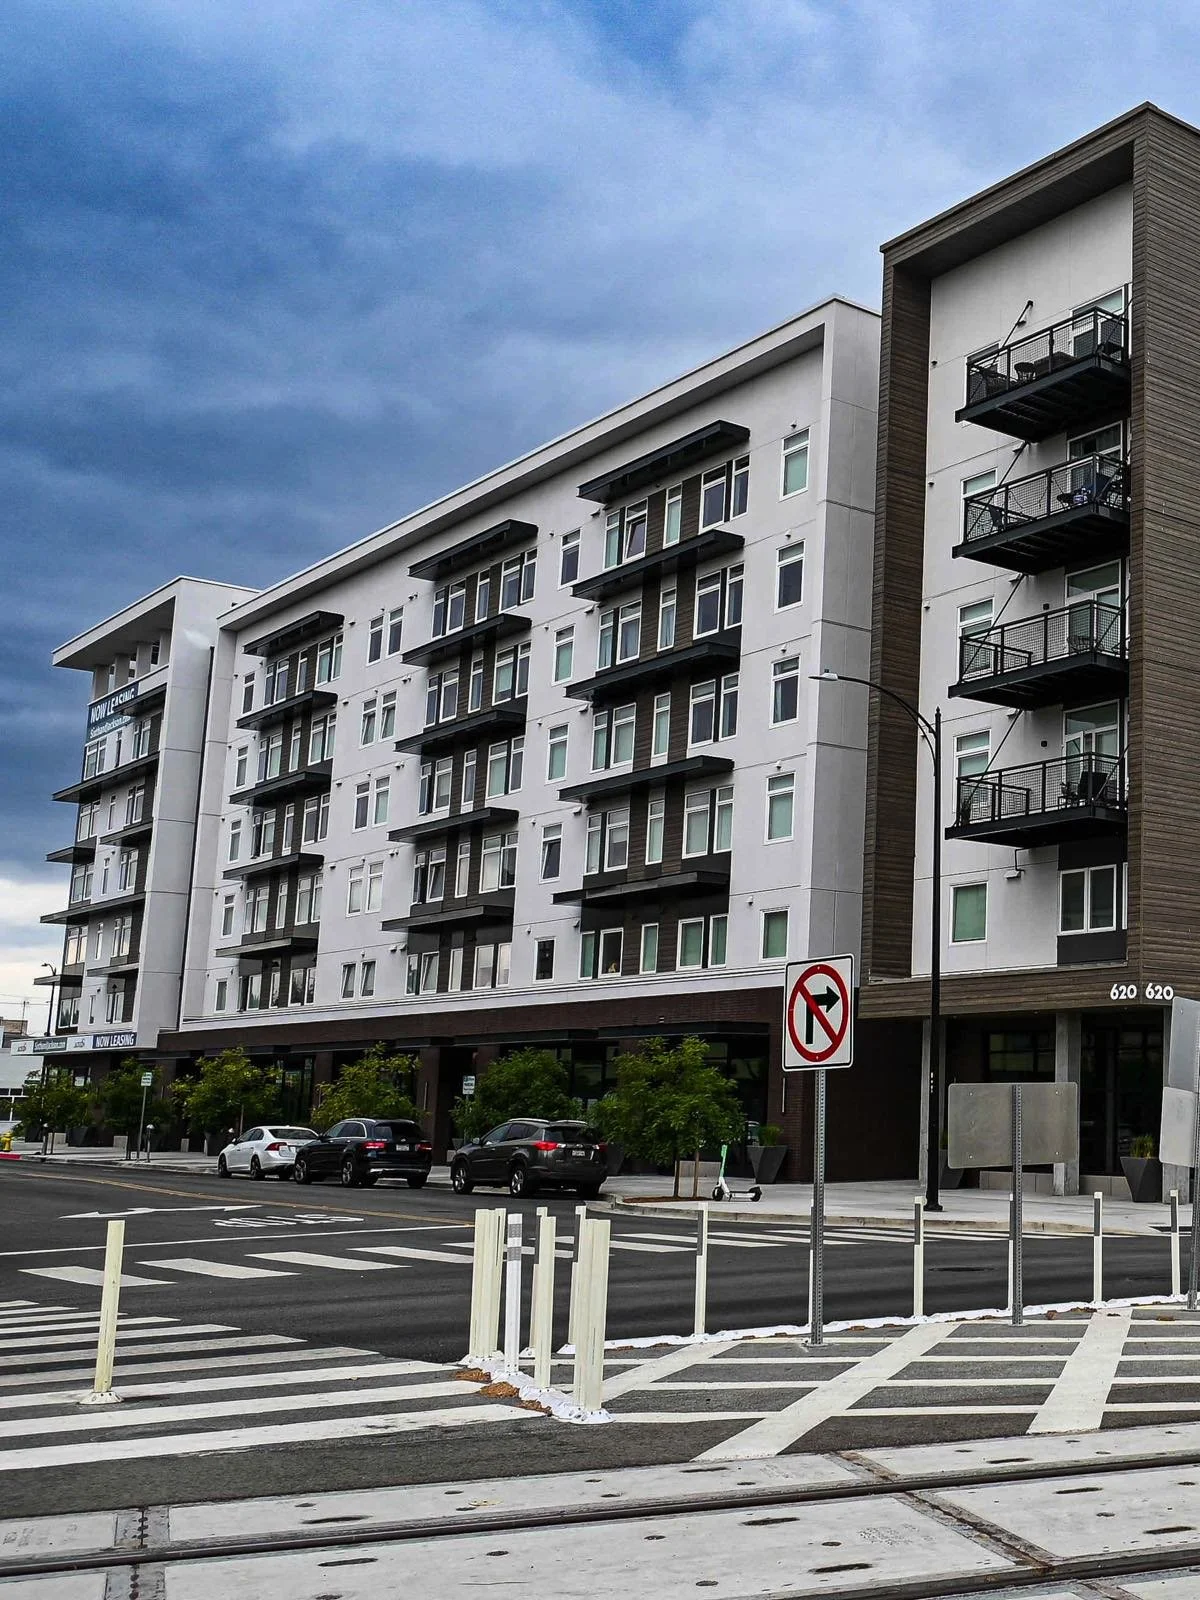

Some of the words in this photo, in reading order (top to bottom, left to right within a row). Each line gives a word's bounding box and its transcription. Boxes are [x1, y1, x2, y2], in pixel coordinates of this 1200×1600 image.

[90, 702, 108, 724] NOW
[1110, 983, 1138, 1001] 620
[1145, 982, 1174, 1001] 620
[95, 1035, 110, 1048] NOW
[110, 1033, 135, 1047] LEASING
